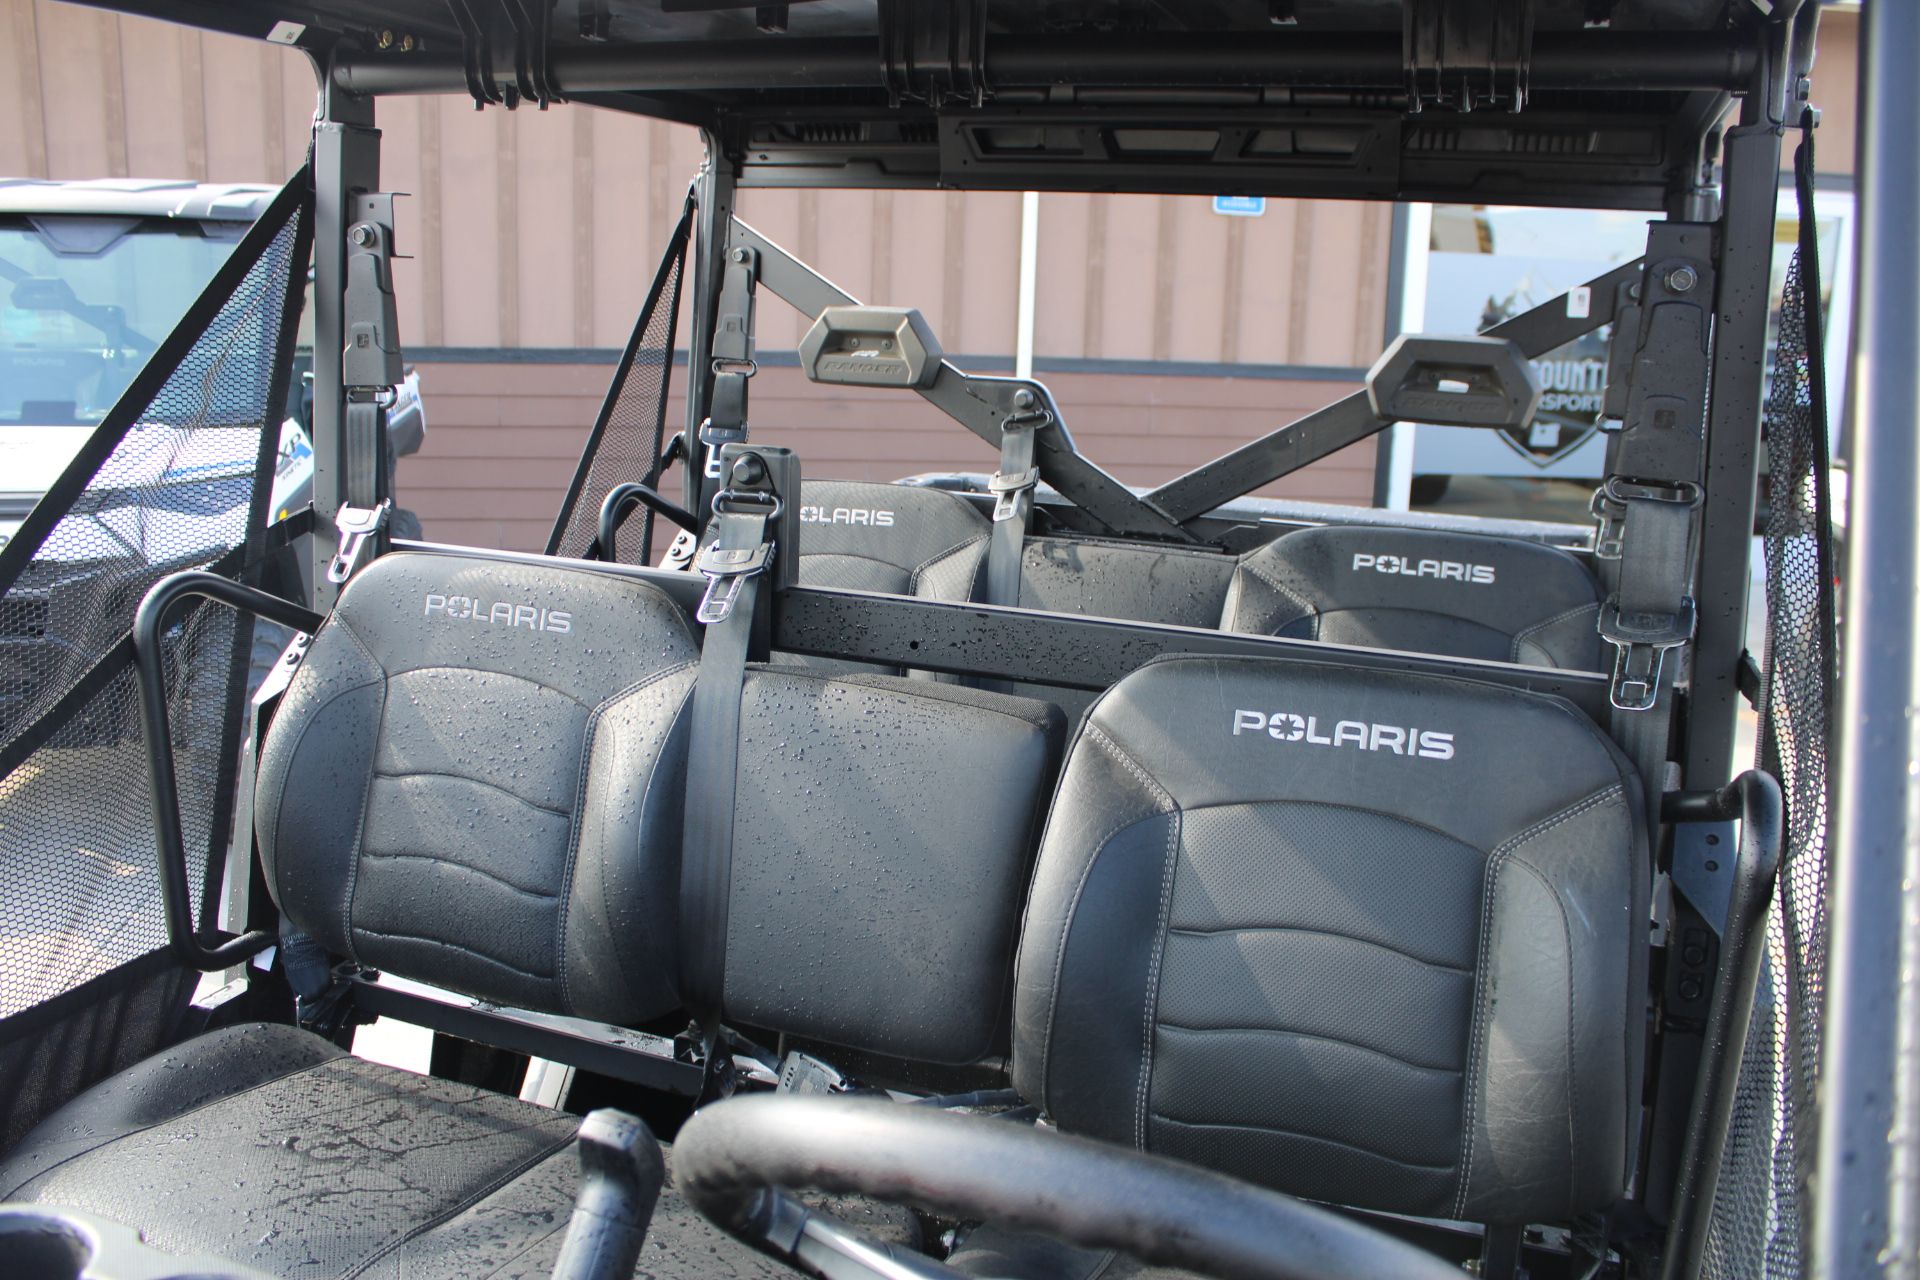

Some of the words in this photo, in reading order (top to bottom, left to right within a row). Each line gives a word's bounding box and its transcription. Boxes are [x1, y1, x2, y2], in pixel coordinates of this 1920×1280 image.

[1529, 359, 1608, 392] OUNT
[800, 506, 895, 527] OLARIS
[1353, 553, 1496, 584] POLARIS
[424, 594, 572, 634] POLARIS
[1233, 709, 1454, 760] POLARIS
